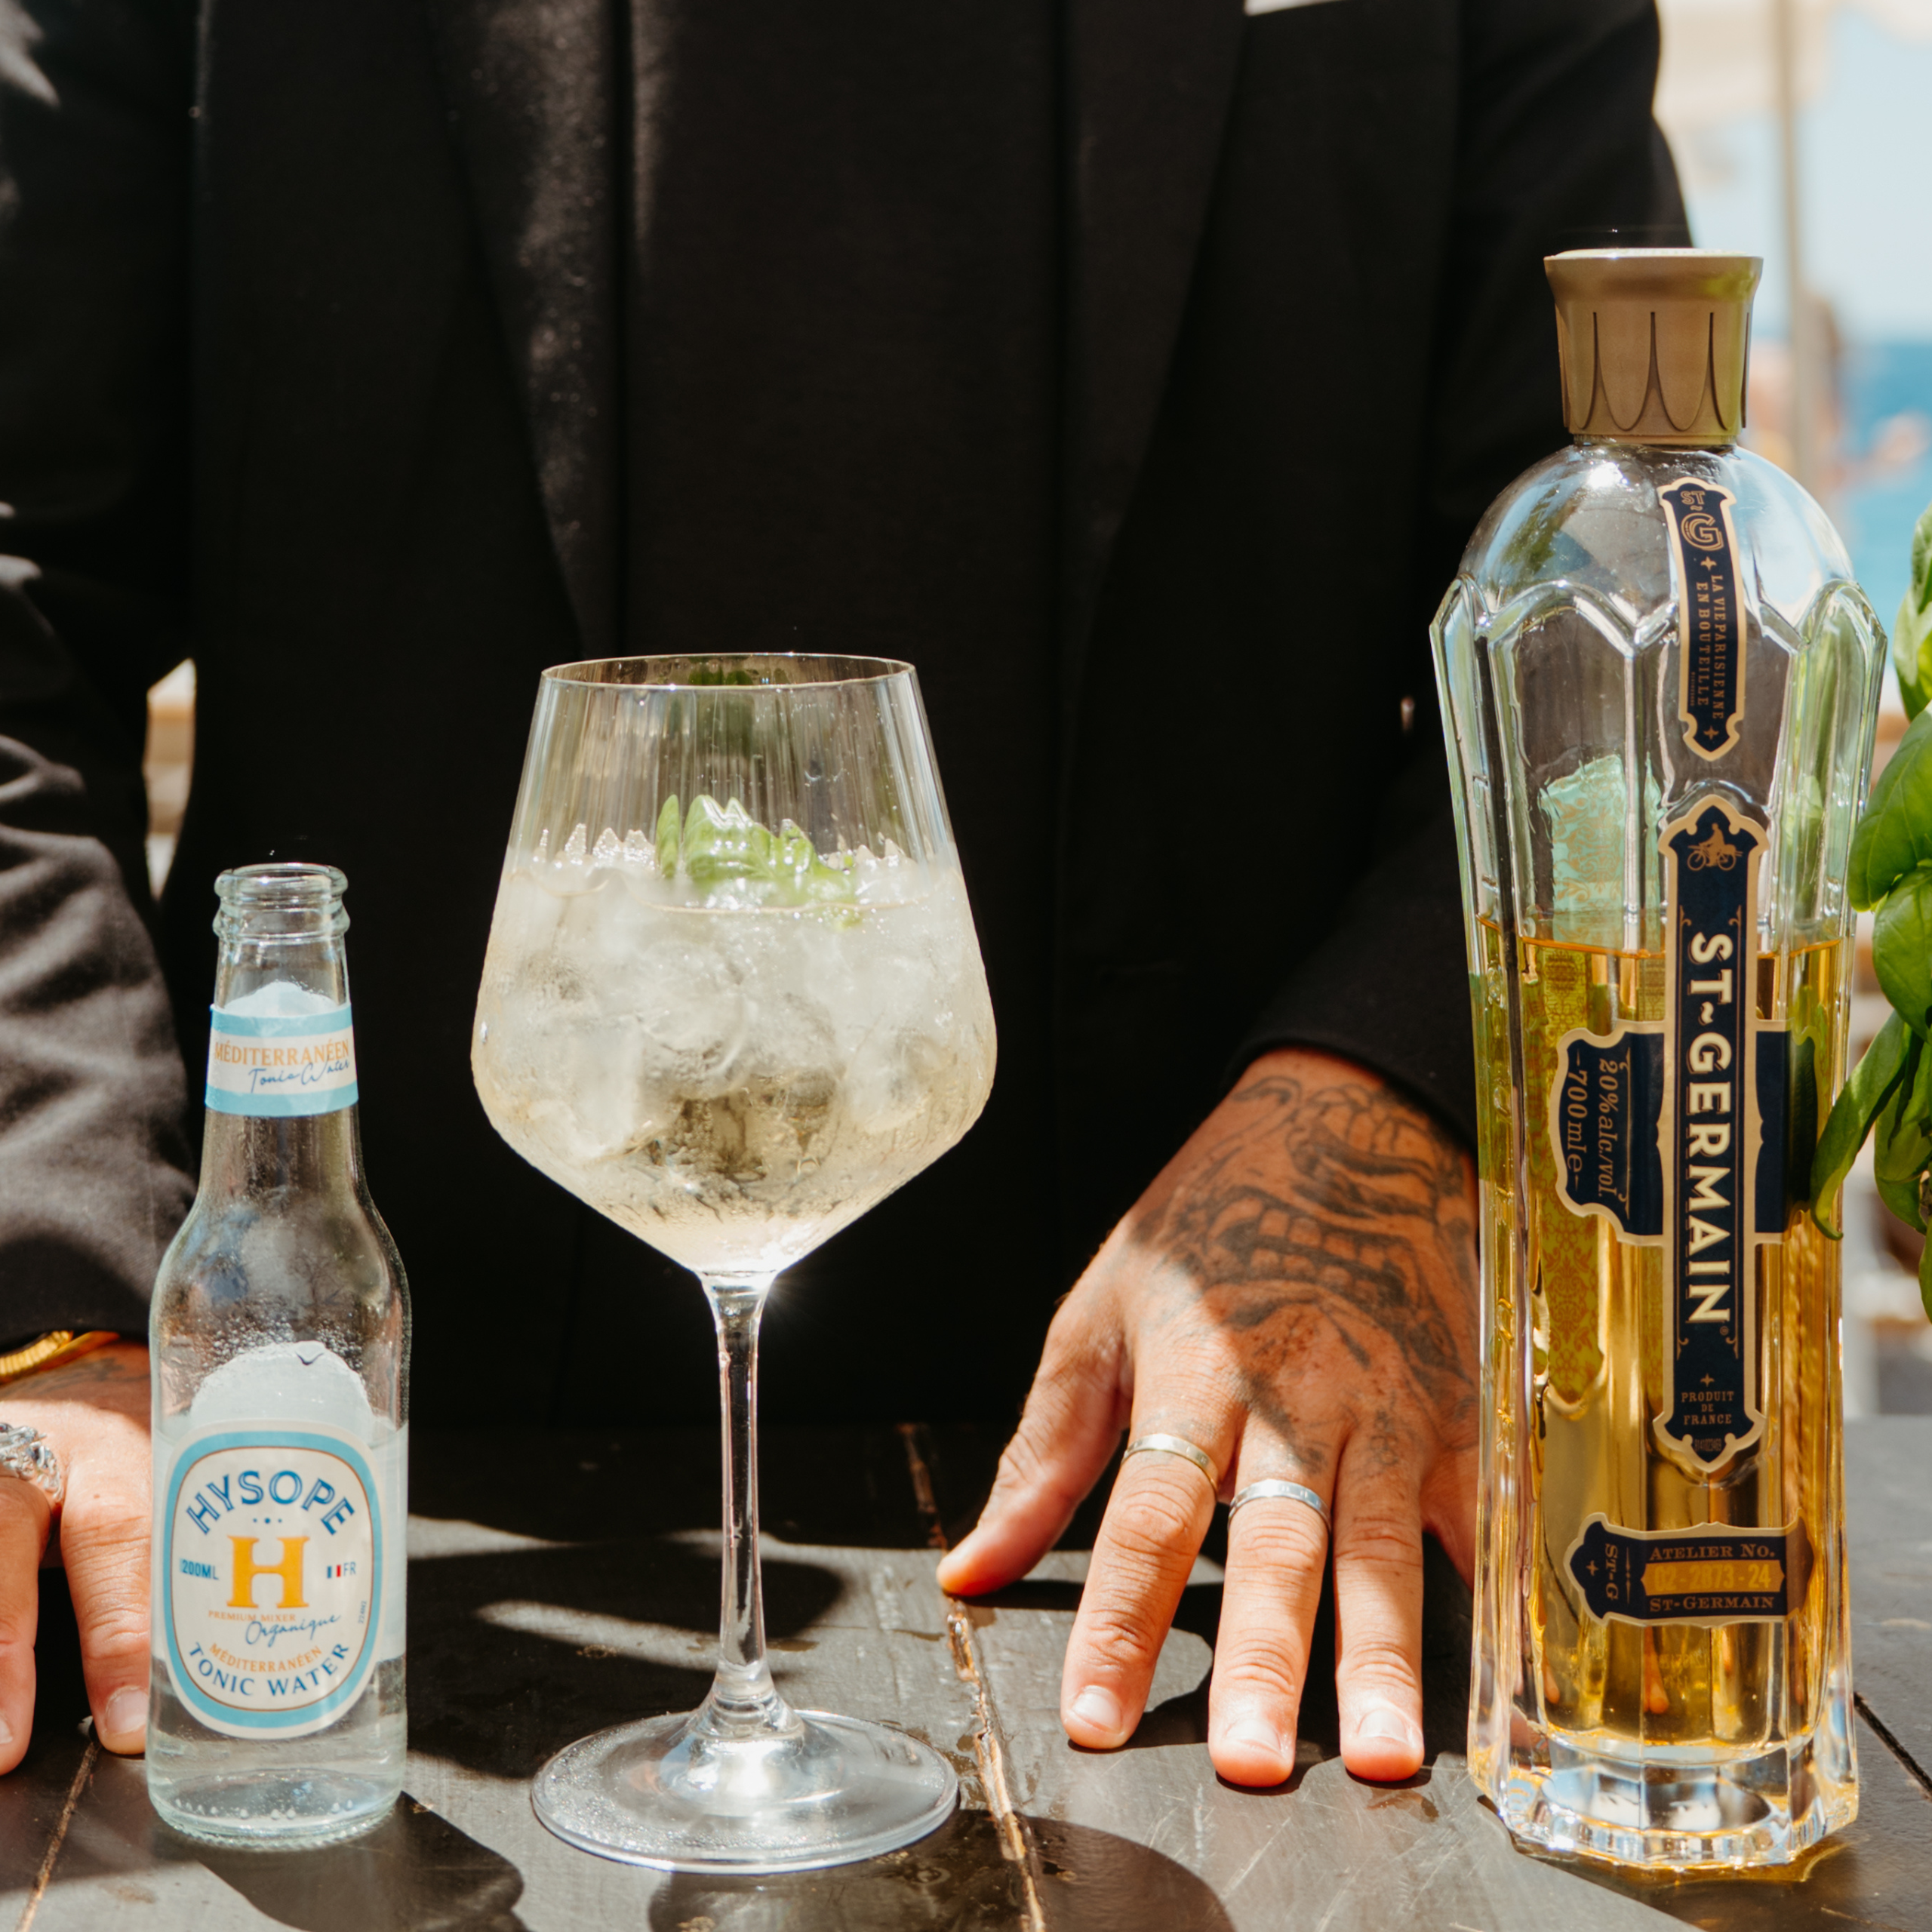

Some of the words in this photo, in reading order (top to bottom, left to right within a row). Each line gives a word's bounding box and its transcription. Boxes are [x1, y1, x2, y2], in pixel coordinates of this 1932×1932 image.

[1681, 491, 1706, 505] ST
[1681, 512, 1724, 551] G
[1695, 582, 1709, 603] EN
[1710, 574, 1724, 592] LA
[1712, 597, 1727, 621] VIE
[1697, 608, 1712, 706] BOUTEILLE
[1712, 623, 1727, 720] PARISIENNE
[214, 1038, 349, 1067] MÉDITERRANÉEN
[248, 1068, 300, 1094] Tonic
[301, 1054, 350, 1086] Water
[1681, 1391, 1735, 1403] PRODUIT
[1701, 1404, 1715, 1413] DE
[1683, 1413, 1733, 1426] FRANCE
[185, 1470, 356, 1536] HYSOPE
[1649, 1546, 1734, 1561] ATELIER
[181, 1558, 220, 1581] 200ML
[226, 1535, 310, 1609] H
[343, 1561, 357, 1577] FR
[208, 1610, 257, 1622] PREMIUM
[260, 1614, 296, 1623] MIXER
[245, 1614, 341, 1648] Organique
[188, 1641, 255, 1697] TONIC
[267, 1641, 349, 1697] WATER
[209, 1642, 324, 1673] MÉDITERRANÉEN
